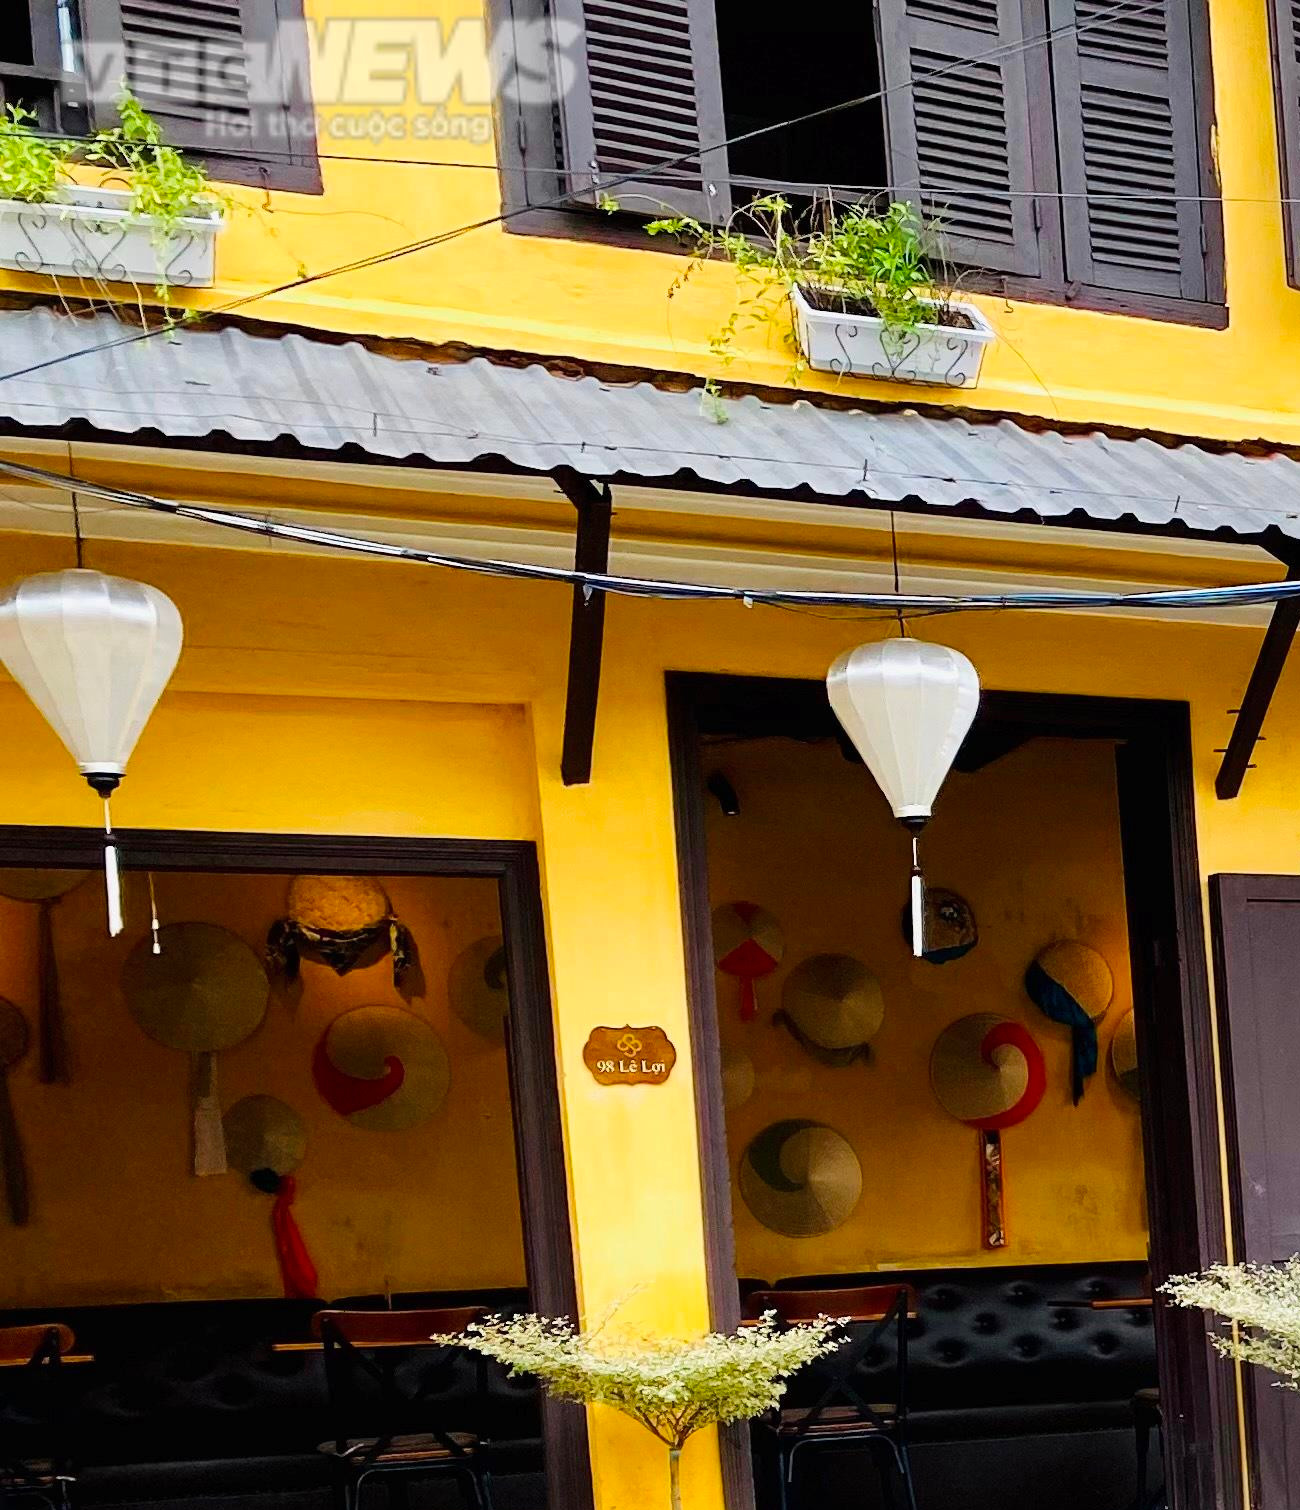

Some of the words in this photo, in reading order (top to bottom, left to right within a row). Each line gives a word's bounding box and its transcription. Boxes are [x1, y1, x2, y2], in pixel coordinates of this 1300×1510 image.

[596, 1060, 615, 1073] 98
[619, 1059, 638, 1073] Lê
[641, 1059, 666, 1075] Lợi
